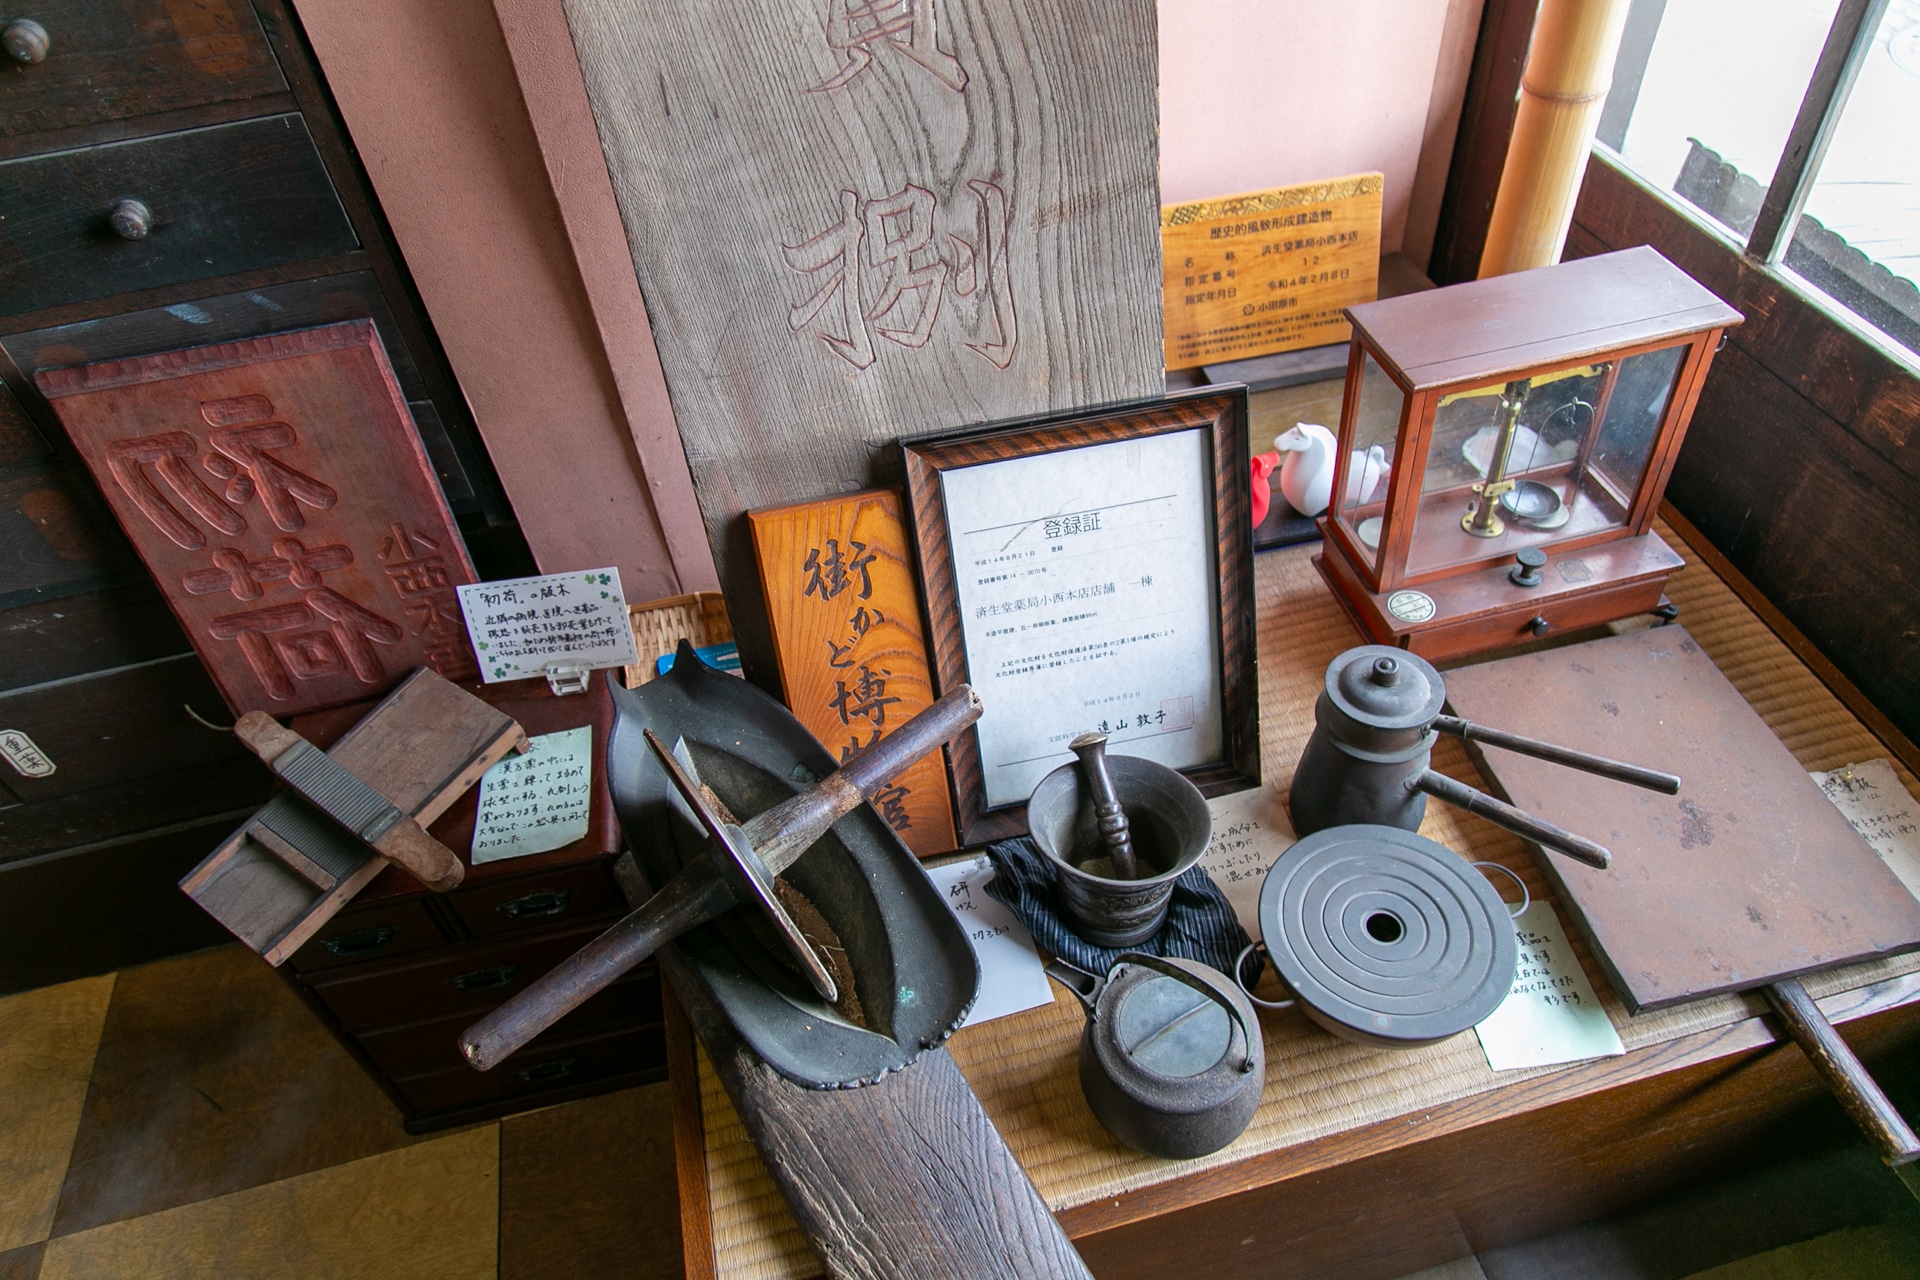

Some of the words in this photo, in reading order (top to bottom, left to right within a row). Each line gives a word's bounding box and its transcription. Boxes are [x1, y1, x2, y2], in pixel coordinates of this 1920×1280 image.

[1210, 209, 1333, 240] 歴史的風致形成建造物
[1261, 230, 1359, 257] 済生堂薬局小西本店
[1185, 287, 1237, 306] 指定年月日
[1258, 298, 1298, 313] 小田原市
[1043, 512, 1102, 540] 登録証
[975, 581, 1116, 619] 済生堂薬局小西本店店舗
[950, 881, 970, 898] 研
